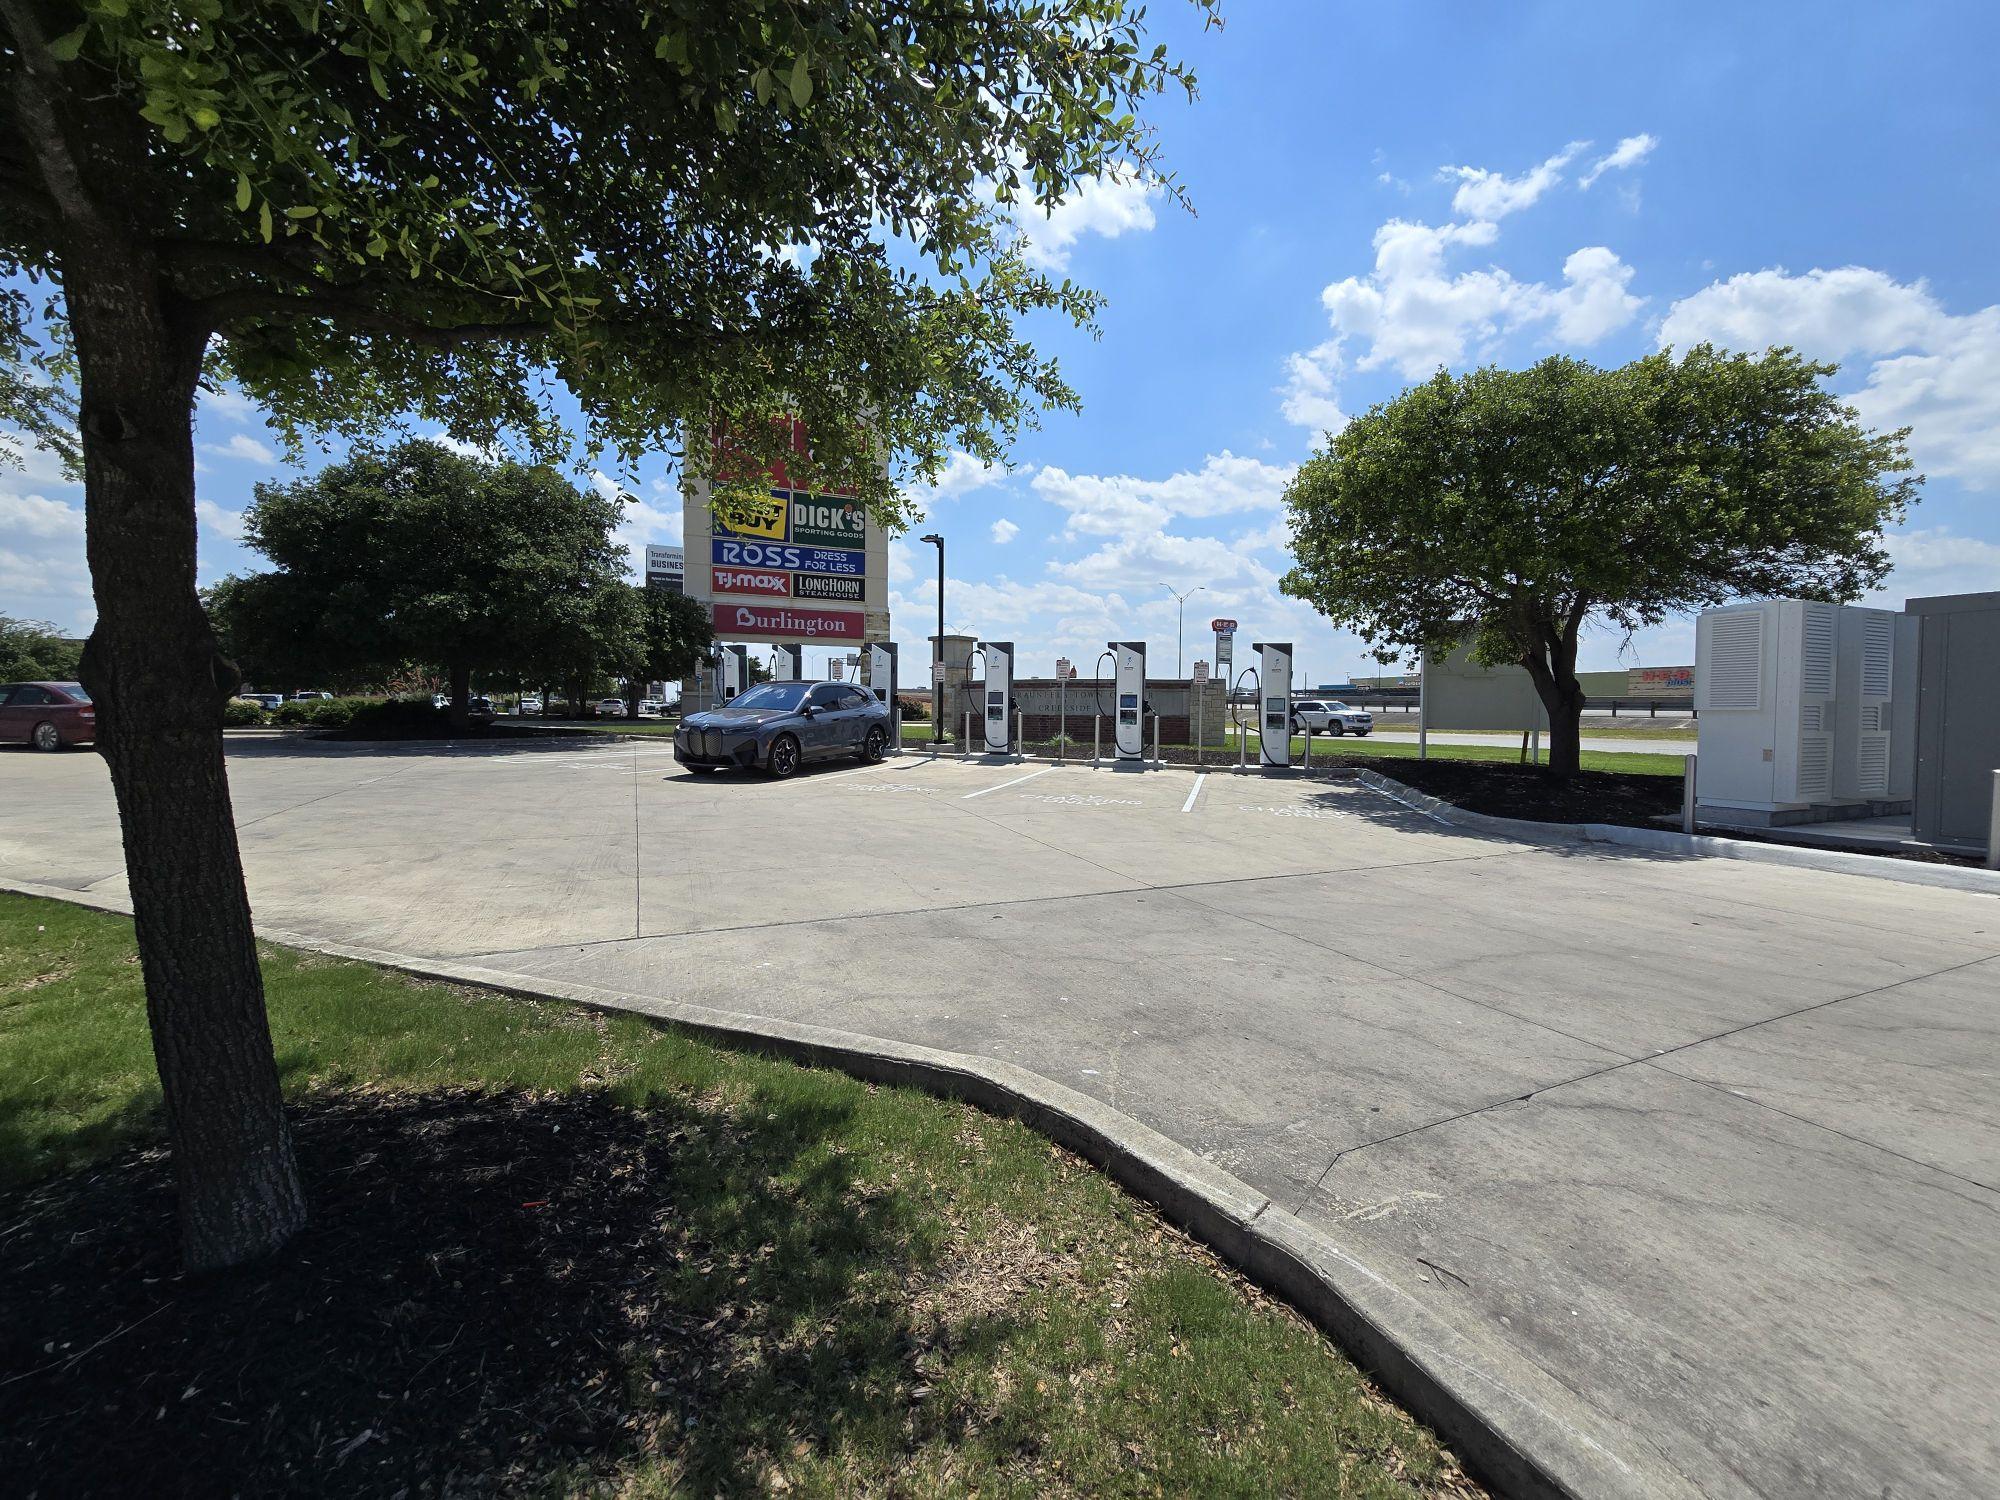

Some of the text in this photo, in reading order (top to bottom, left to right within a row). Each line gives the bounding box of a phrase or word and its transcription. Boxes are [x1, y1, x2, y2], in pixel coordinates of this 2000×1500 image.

[730, 511, 778, 530] BUY
[794, 504, 865, 531] DICK'S
[794, 527, 864, 539] SPORTING GOODS
[723, 543, 801, 568] ROSS
[814, 550, 847, 561] DRESS
[805, 561, 856, 572] FOR LESS
[799, 576, 860, 593] LONGHORN
[799, 591, 860, 599] STEAKHOUSE
[736, 607, 847, 636] Burlington
